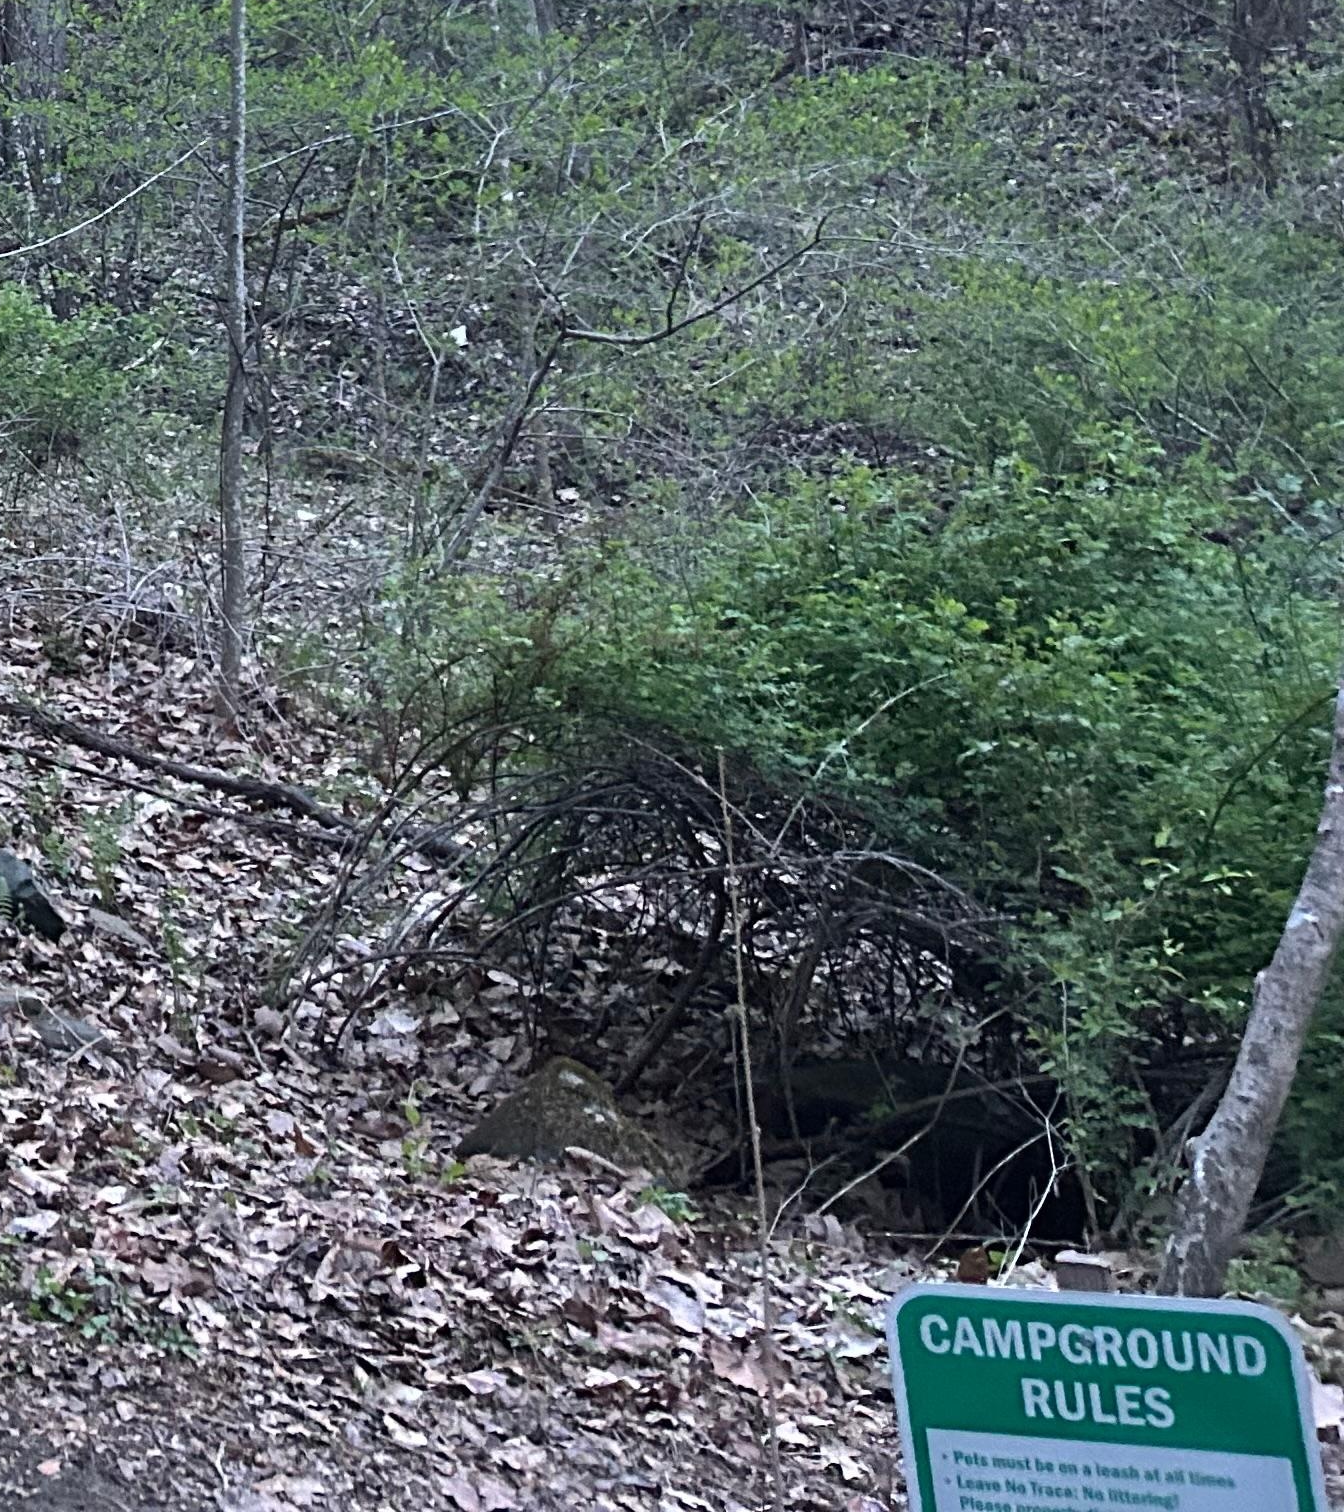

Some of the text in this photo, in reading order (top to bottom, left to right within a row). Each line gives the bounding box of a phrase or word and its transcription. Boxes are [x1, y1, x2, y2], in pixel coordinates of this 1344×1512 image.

[919, 1313, 1267, 1377] CAMPGROUND
[1020, 1377, 1176, 1429] RULES
[953, 1450, 1236, 1489] Pets must be on a leash at all times
[956, 1474, 1001, 1492] Leave
[1004, 1478, 1026, 1494] No
[1082, 1486, 1105, 1502] No
[959, 1495, 1012, 1512] Please
